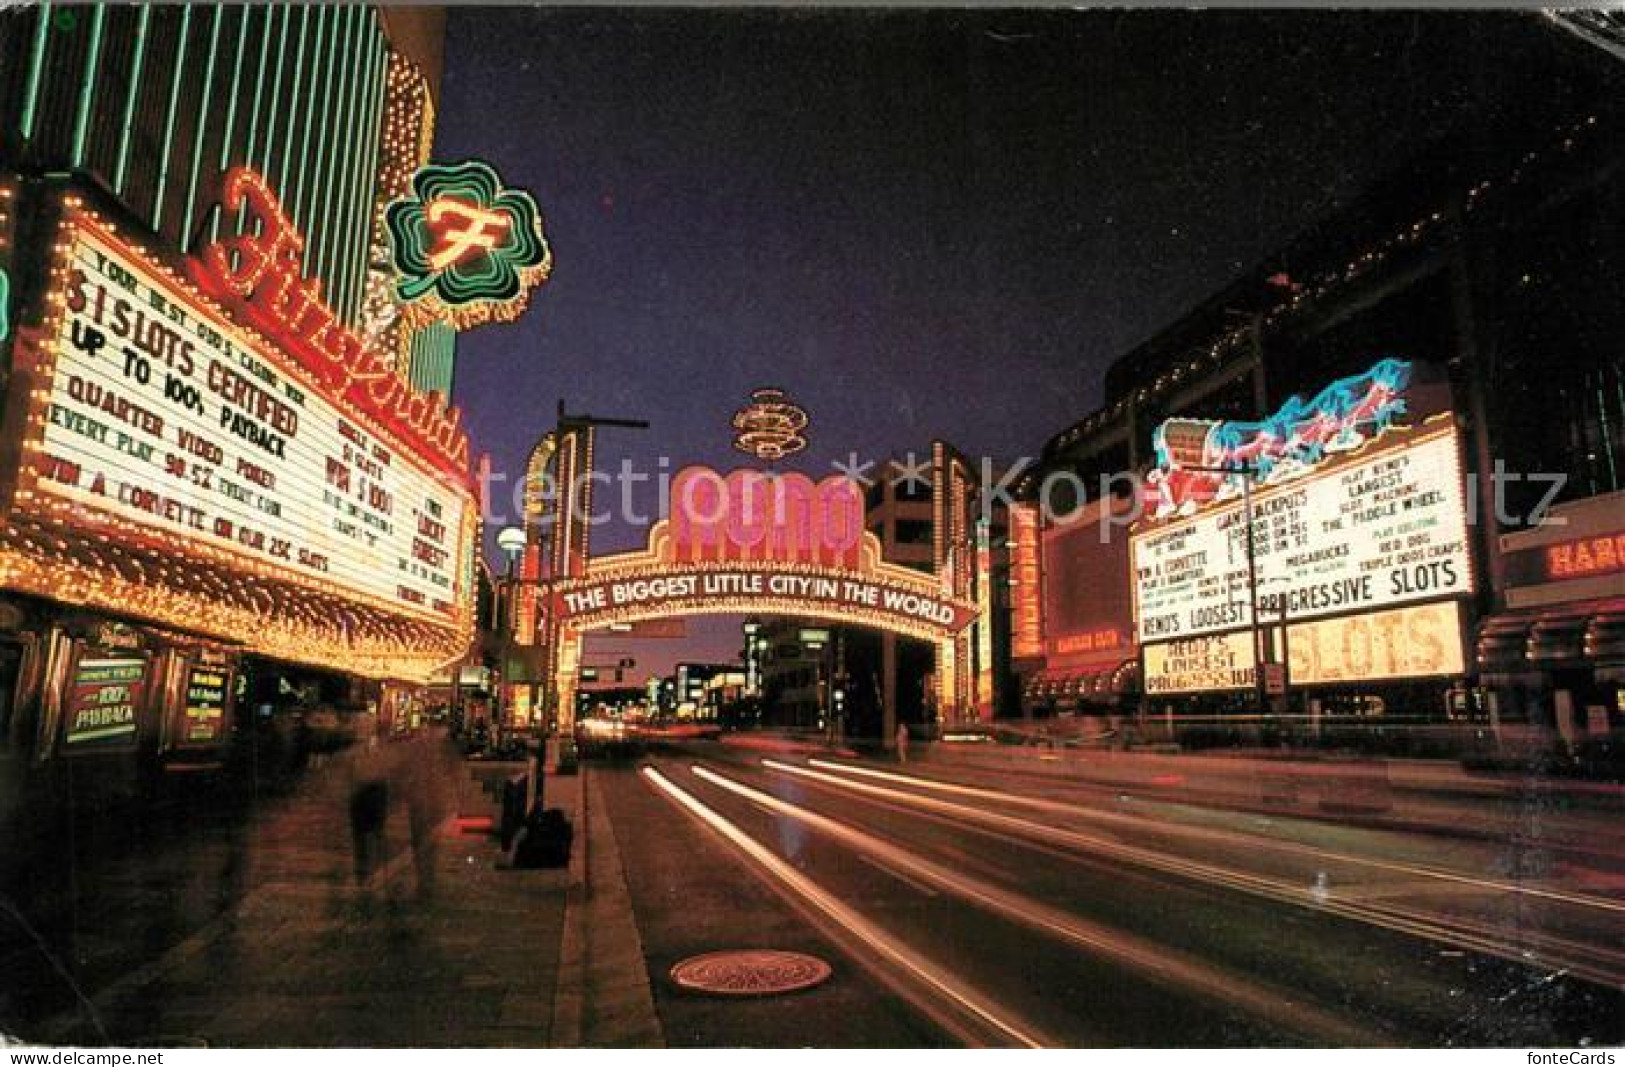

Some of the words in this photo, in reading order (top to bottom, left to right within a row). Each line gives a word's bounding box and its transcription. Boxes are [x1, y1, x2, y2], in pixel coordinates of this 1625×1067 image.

[425, 197, 513, 272] F
[71, 319, 105, 356] UP
[123, 347, 149, 385] TO
[221, 405, 286, 460] PAYBACK
[110, 299, 195, 377] SLOTS
[208, 359, 298, 438] CERTIFIED
[50, 404, 109, 444] EVERY
[117, 431, 154, 462] PLAY
[68, 375, 164, 438] QUARTER
[178, 427, 223, 465] VIDEO
[90, 470, 105, 496] A
[118, 482, 206, 531] CORVETTE
[1349, 470, 1402, 497] LARGEST
[564, 586, 607, 614] THE
[612, 575, 697, 605] BIGGEST
[704, 574, 762, 594] LITTLE
[769, 574, 810, 595] CITY
[815, 577, 839, 598] IN
[843, 581, 878, 605] THE
[883, 589, 955, 624] WORLD
[1190, 600, 1245, 631] LOOSEST
[1259, 575, 1373, 616] PRGRESSIVE
[1390, 559, 1457, 596] SLOTS
